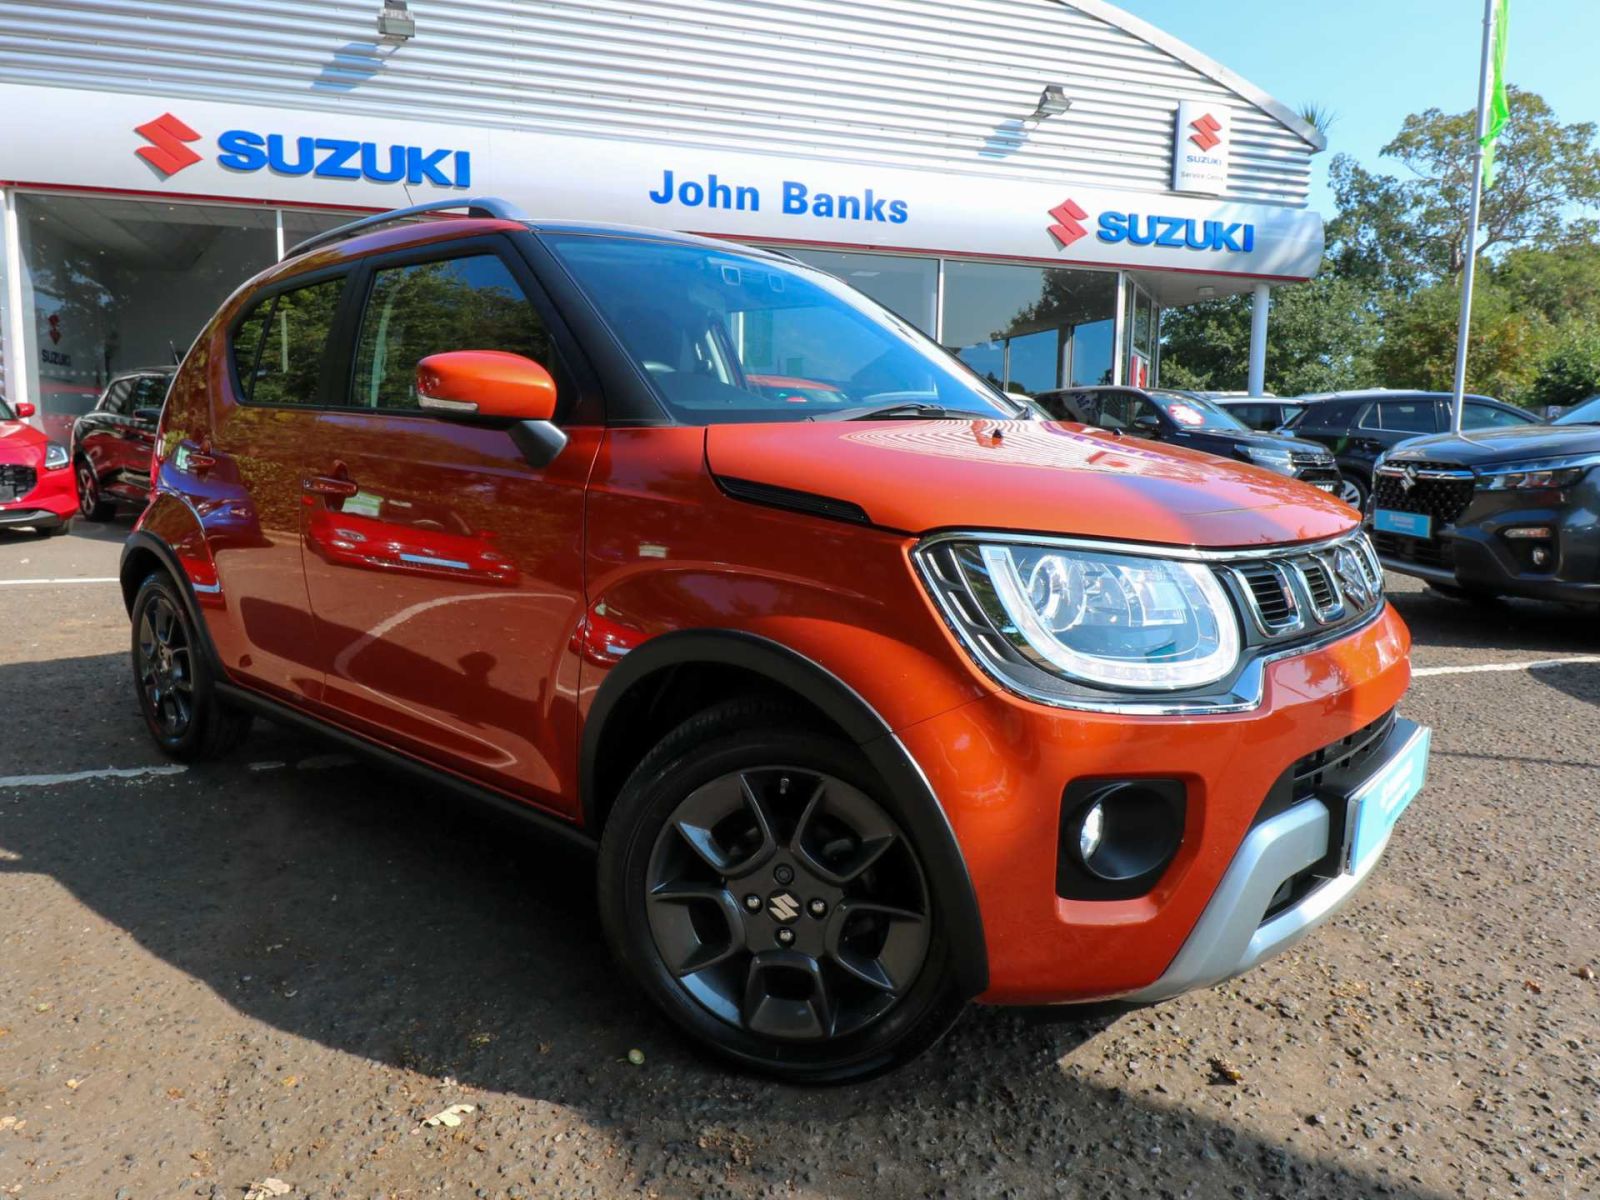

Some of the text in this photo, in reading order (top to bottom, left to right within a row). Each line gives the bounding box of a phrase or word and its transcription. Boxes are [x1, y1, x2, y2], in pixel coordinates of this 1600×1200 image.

[217, 129, 471, 188] SUZUKI
[1186, 154, 1222, 166] SUZUKI
[648, 169, 909, 225] John Banks
[1097, 210, 1255, 253] SUZUKI
[42, 349, 72, 367] SUZUKI
